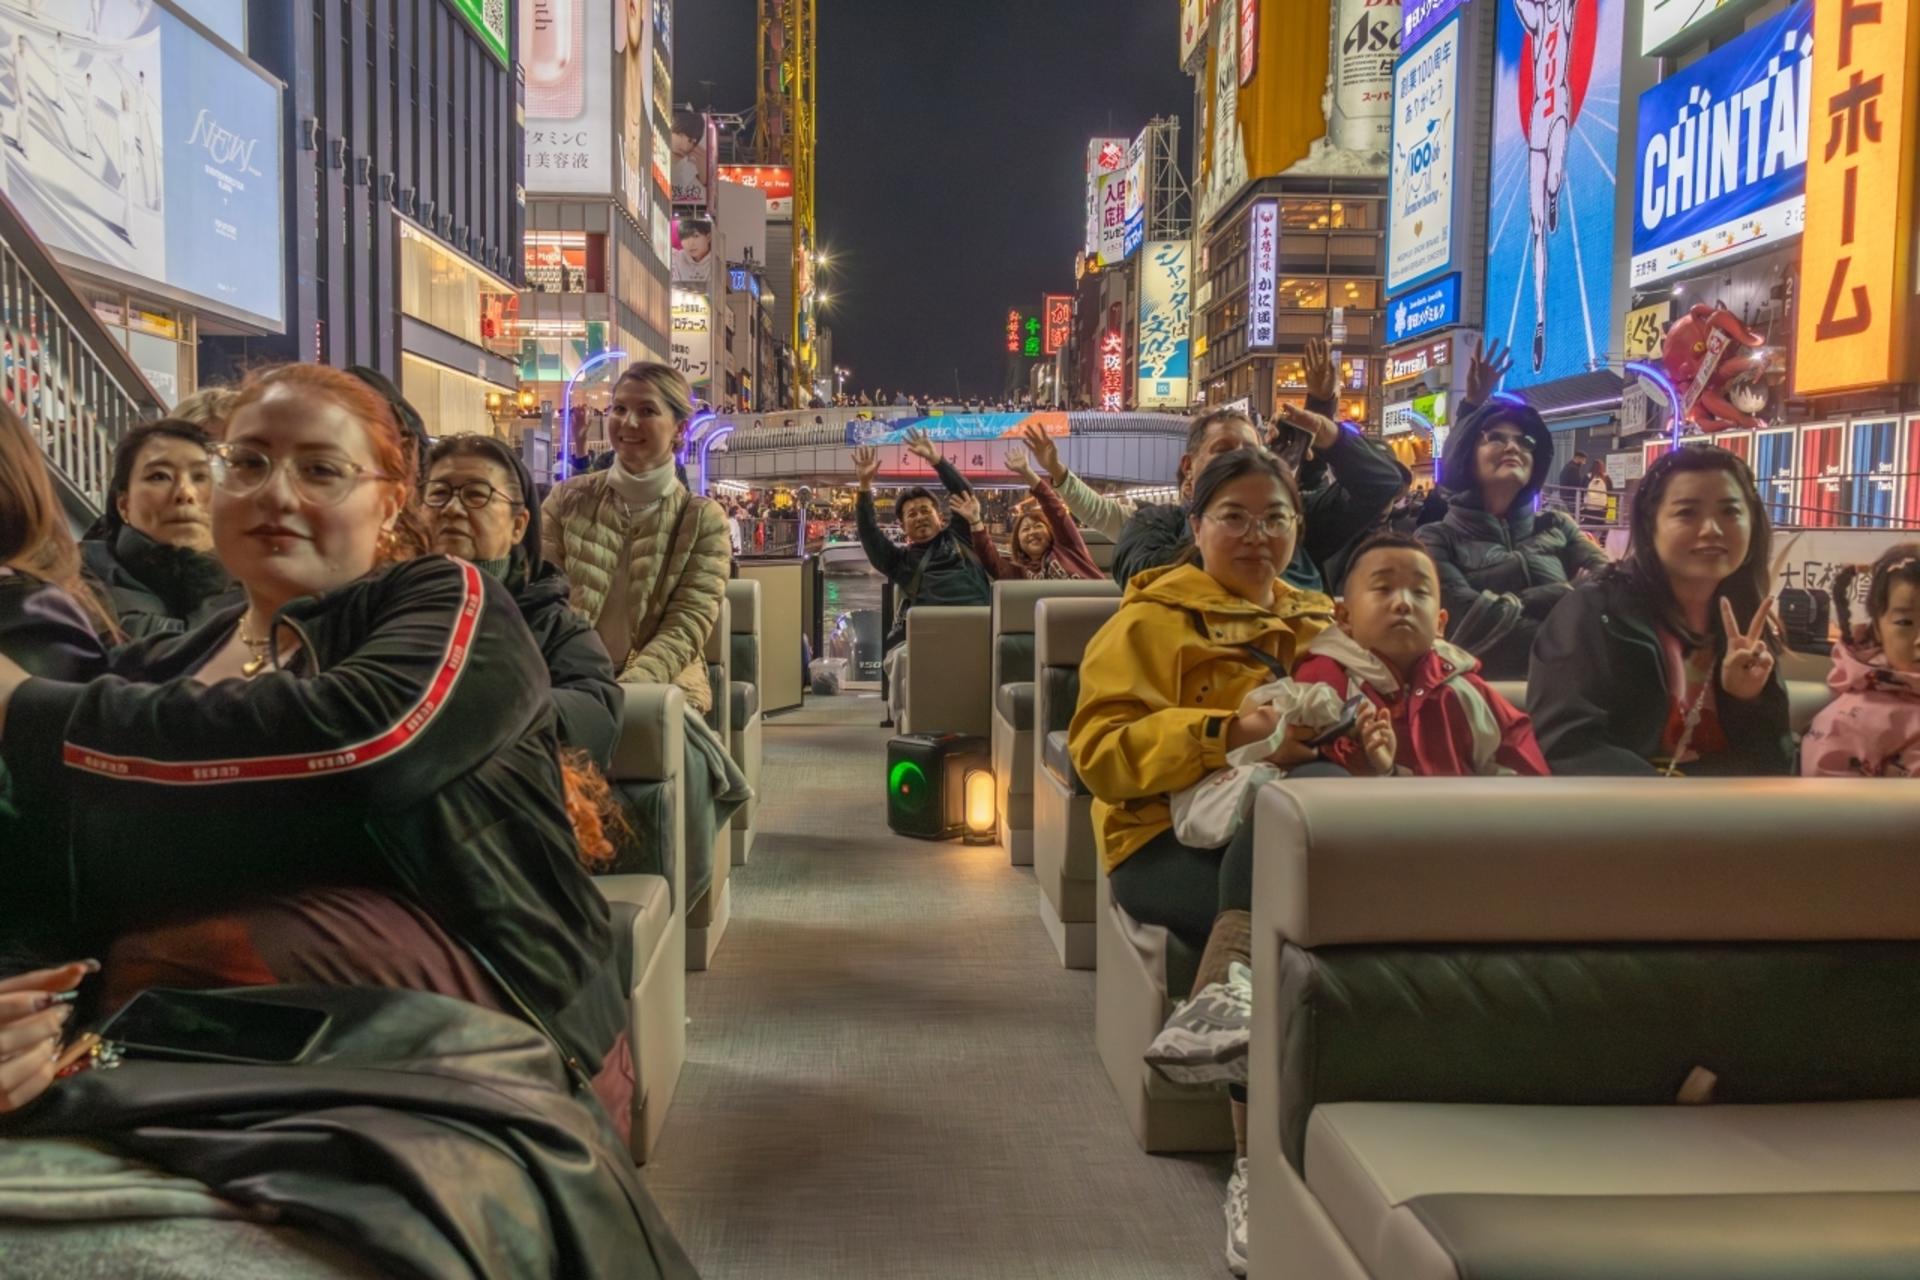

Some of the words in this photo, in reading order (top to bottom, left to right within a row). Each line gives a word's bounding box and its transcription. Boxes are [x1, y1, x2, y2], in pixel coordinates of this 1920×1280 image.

[1543, 22, 1560, 118] グリコ
[1362, 91, 1393, 102] スーパ
[1257, 277, 1272, 342] かに道楽
[901, 453, 985, 467] えす橋
[858, 660, 882, 669] 150
[307, 751, 357, 770] GUESS
